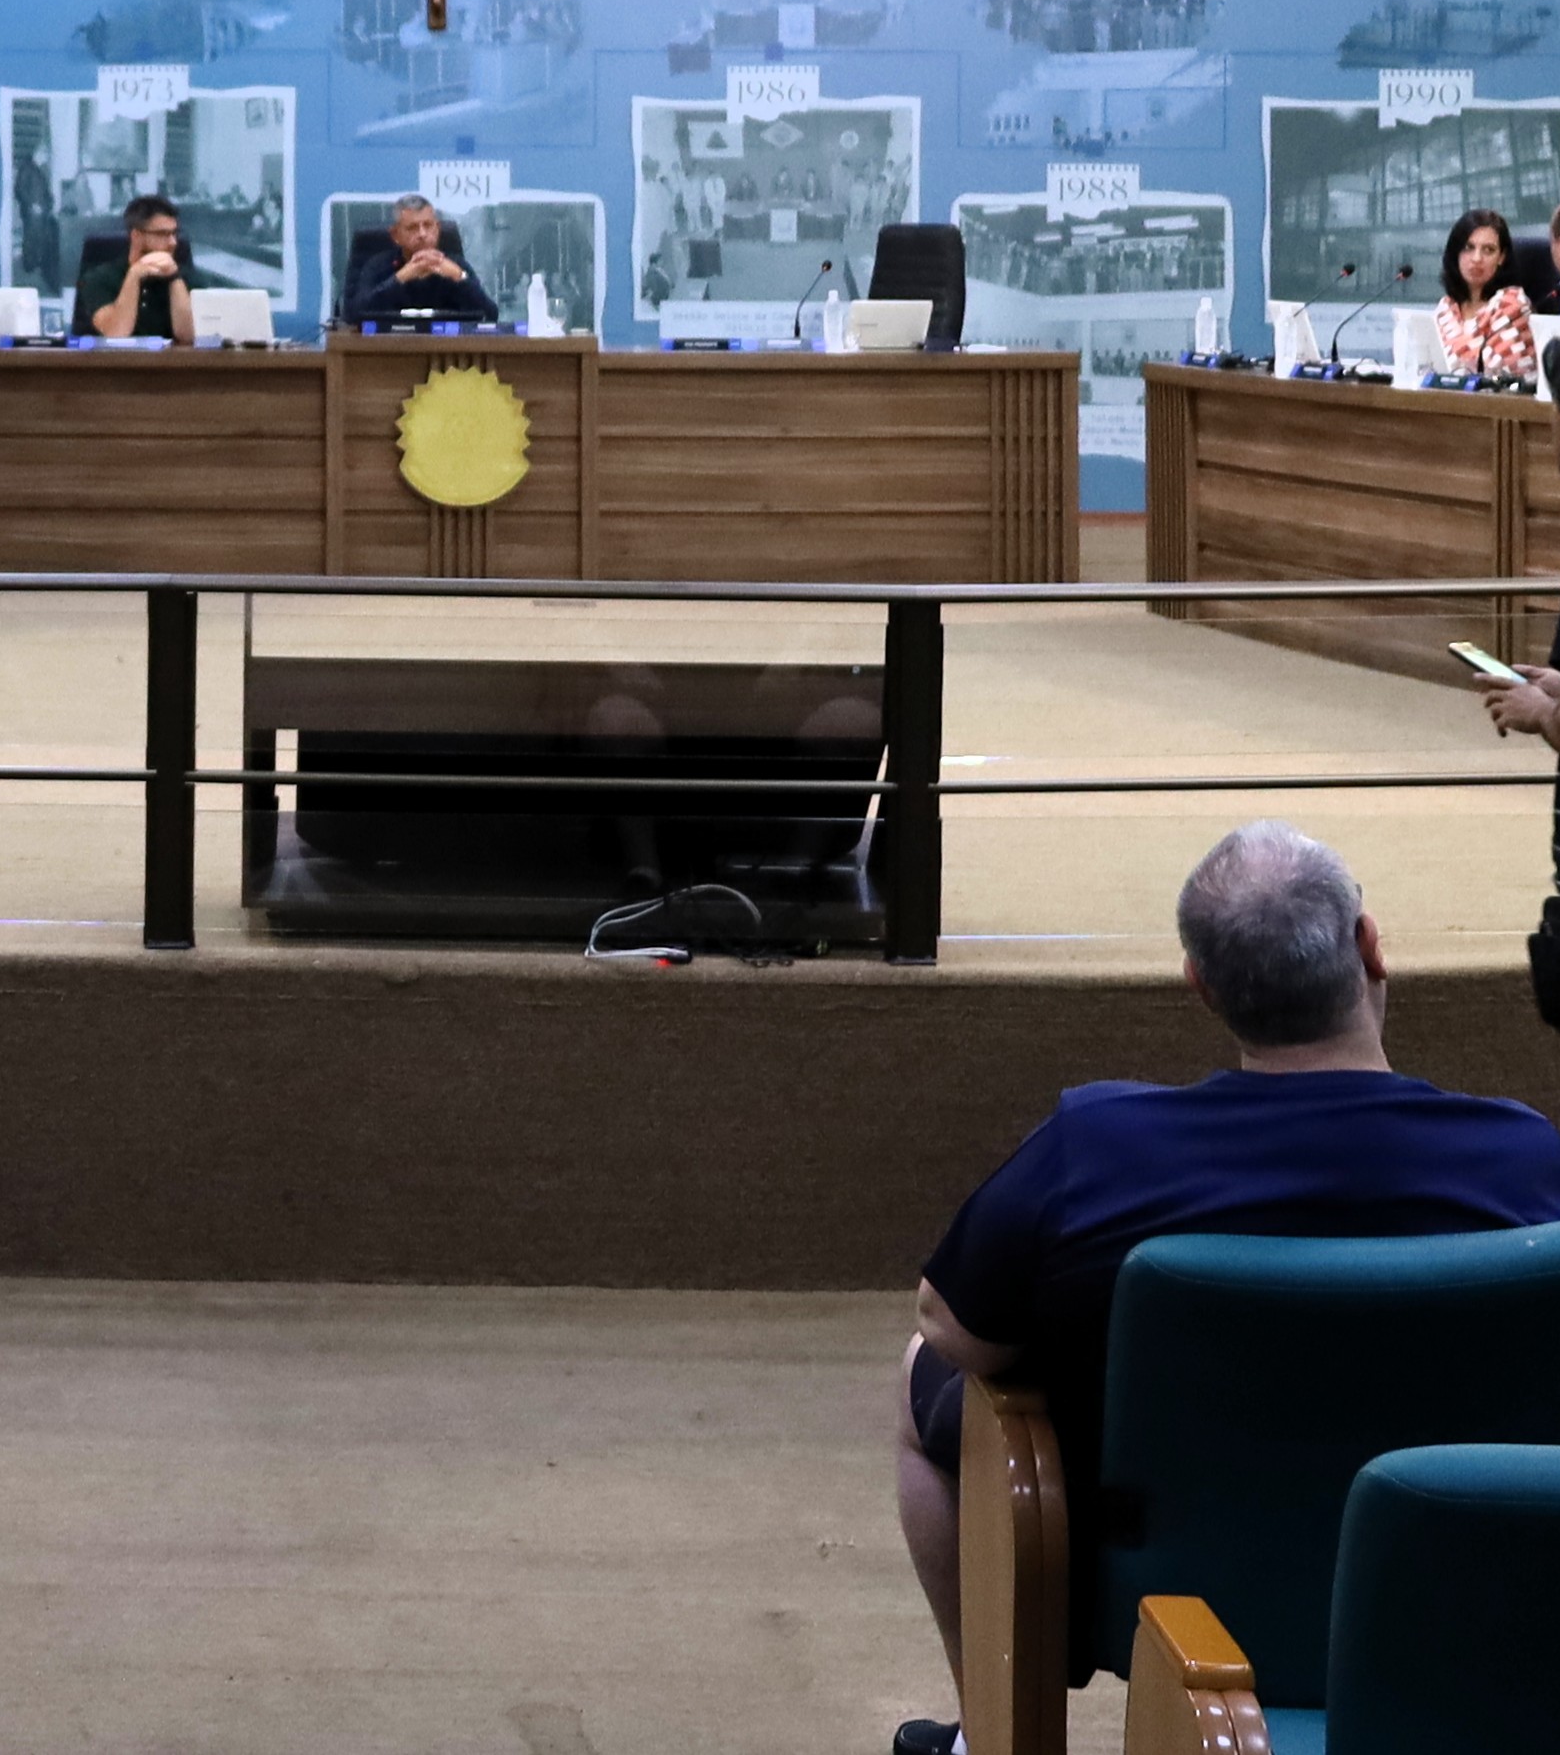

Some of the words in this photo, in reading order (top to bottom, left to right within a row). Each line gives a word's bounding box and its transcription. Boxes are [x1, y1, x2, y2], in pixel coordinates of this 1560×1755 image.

[113, 78, 173, 103] 1973
[738, 80, 806, 104] 1986
[1387, 83, 1461, 107] 1990
[435, 174, 491, 199] 1981
[1059, 176, 1129, 202] 1988
